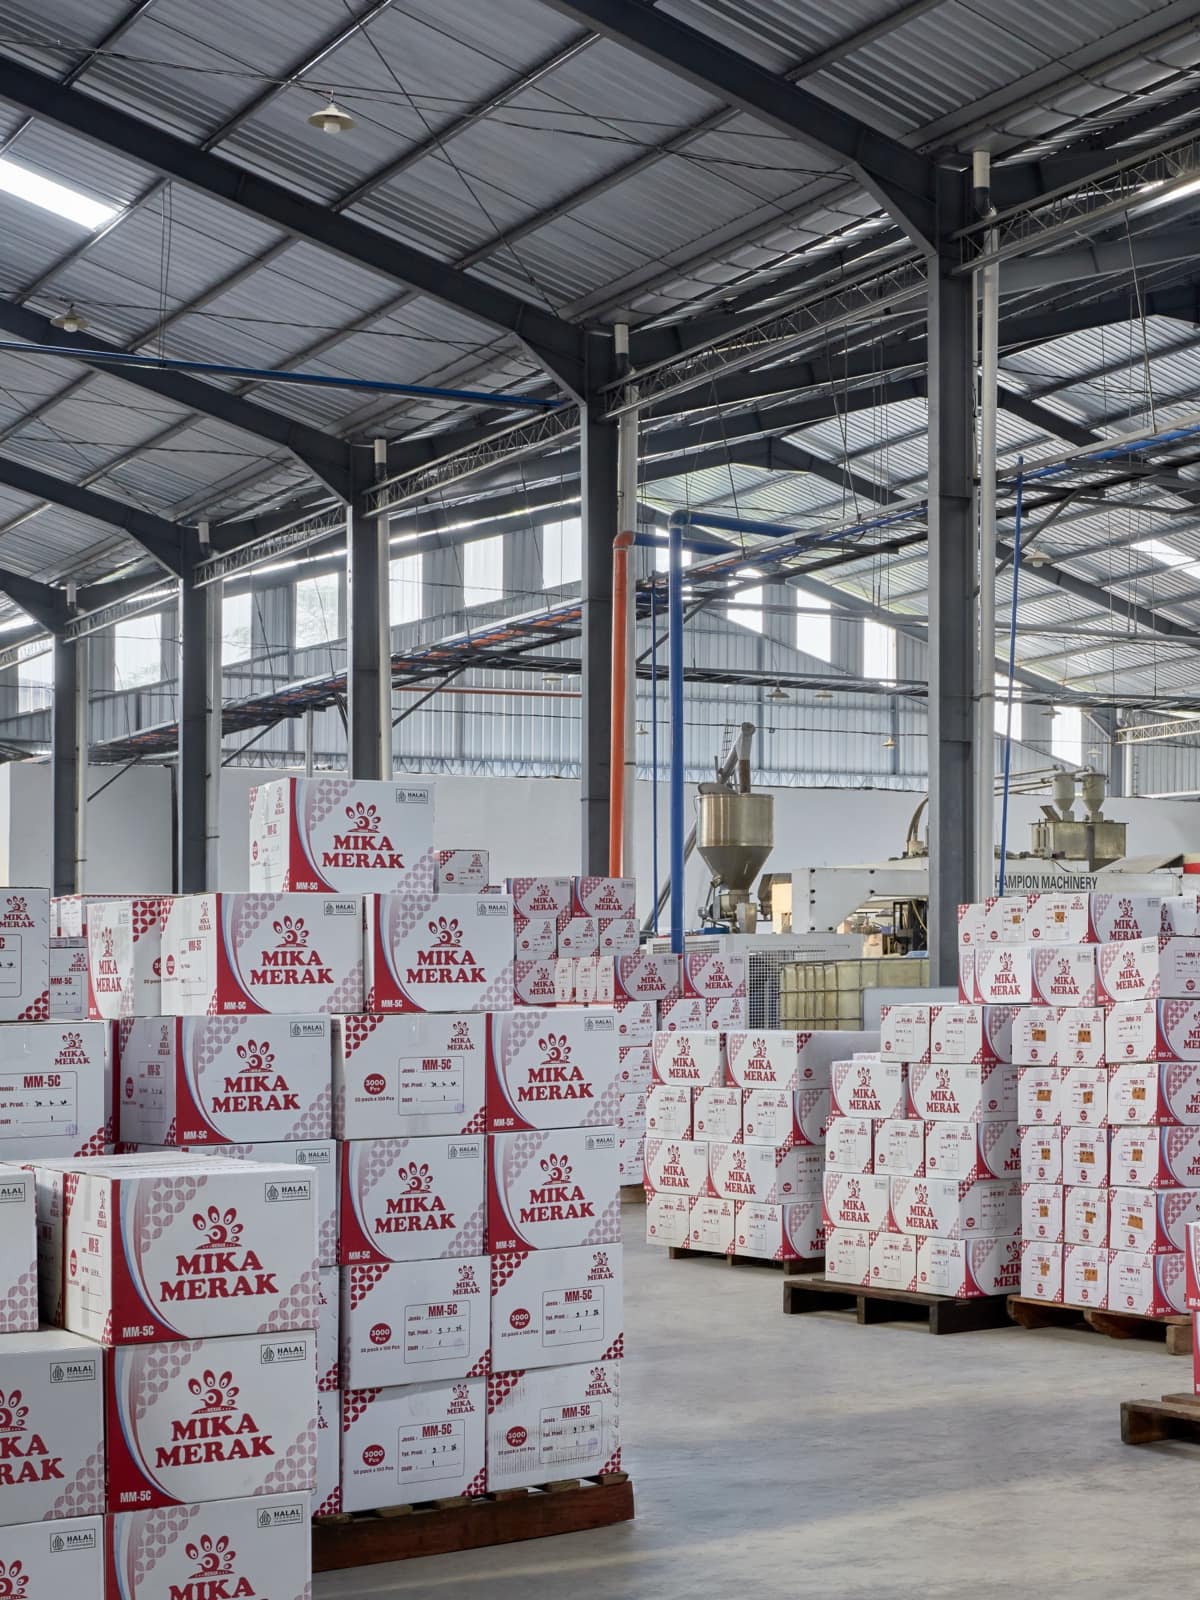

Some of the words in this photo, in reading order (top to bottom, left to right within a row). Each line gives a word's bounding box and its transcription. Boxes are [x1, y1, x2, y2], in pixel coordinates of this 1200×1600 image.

[408, 792, 427, 800] HALAL
[333, 835, 393, 850] MIKA
[322, 852, 405, 868] MERAK
[296, 882, 318, 891] MM-5C
[994, 875, 1039, 889] HAMPION
[1041, 876, 1098, 889] MACHINERY
[335, 904, 354, 914] HALAL
[489, 905, 507, 913] HALAL
[261, 951, 323, 966] MIKA
[417, 950, 476, 965] MIKA
[98, 960, 118, 975] MIKA
[250, 968, 334, 985] MERAK
[406, 968, 486, 983] MERAK
[708, 974, 729, 982] MIKA
[1119, 969, 1140, 979] MIKA
[96, 977, 122, 992] MERAK
[705, 981, 733, 990] MERAK
[1115, 978, 1145, 990] MERAK
[224, 1002, 246, 1010] MM-5C
[381, 1000, 403, 1008] MM-5C
[303, 1024, 322, 1033] HALAL
[59, 1050, 85, 1058] MIKA
[55, 1057, 90, 1065] MERAK
[422, 1059, 452, 1071] MM-5C
[672, 1058, 695, 1068] MIKA
[748, 1060, 772, 1070] MIKA
[528, 1066, 584, 1083] MIKA
[668, 1068, 700, 1079] MERAK
[743, 1070, 776, 1082] MERAK
[24, 1075, 61, 1089] MM-5C
[224, 1075, 289, 1093] MIKA
[365, 1079, 384, 1087] 3000
[517, 1084, 594, 1101] MERAK
[930, 1090, 955, 1101] MIKA
[212, 1096, 300, 1113] MERAK
[926, 1100, 960, 1113] MERAK
[493, 1118, 514, 1127] MM-5C
[184, 1131, 207, 1140] MM-5C
[596, 1137, 613, 1145] HALAL
[728, 1171, 751, 1183] MIKA
[0, 1186, 23, 1195] ALAL
[281, 1185, 308, 1193] HALAL
[725, 1181, 756, 1195] MERAK
[529, 1186, 585, 1204] MIKA
[386, 1196, 445, 1214] MIKA
[910, 1205, 933, 1217] MIKA
[520, 1203, 595, 1223] MERAK
[375, 1213, 456, 1233] MERAK
[906, 1216, 939, 1230] MERAK
[495, 1240, 516, 1249] MM-5C
[349, 1251, 371, 1260] MM-5C
[176, 1250, 264, 1276] MIKA
[587, 1272, 614, 1281] MERAK
[160, 1273, 279, 1302] MERAK
[452, 1287, 480, 1296] MERAK
[565, 1289, 592, 1303] MM-5C
[428, 1304, 458, 1317] MM-5C
[511, 1313, 529, 1321] 3000
[122, 1325, 154, 1338] MM-5C
[371, 1328, 390, 1336] 3000
[277, 1346, 305, 1355] HALAL
[66, 1365, 93, 1373] HALAL
[588, 1382, 608, 1390] MIKA
[585, 1388, 612, 1397] MERAK
[447, 1406, 475, 1415] MERAK
[562, 1405, 591, 1419] MM-5C
[171, 1413, 259, 1442] MIKA
[422, 1423, 452, 1437] MM-5C
[0, 1434, 49, 1458] KA
[155, 1435, 275, 1468] MERAK
[364, 1450, 383, 1458] 3000
[0, 1457, 65, 1486] RAK
[120, 1491, 151, 1503] MM-5C
[274, 1509, 301, 1518] HALAL
[66, 1534, 93, 1543] HALAL
[169, 1576, 256, 1600] MIKA
